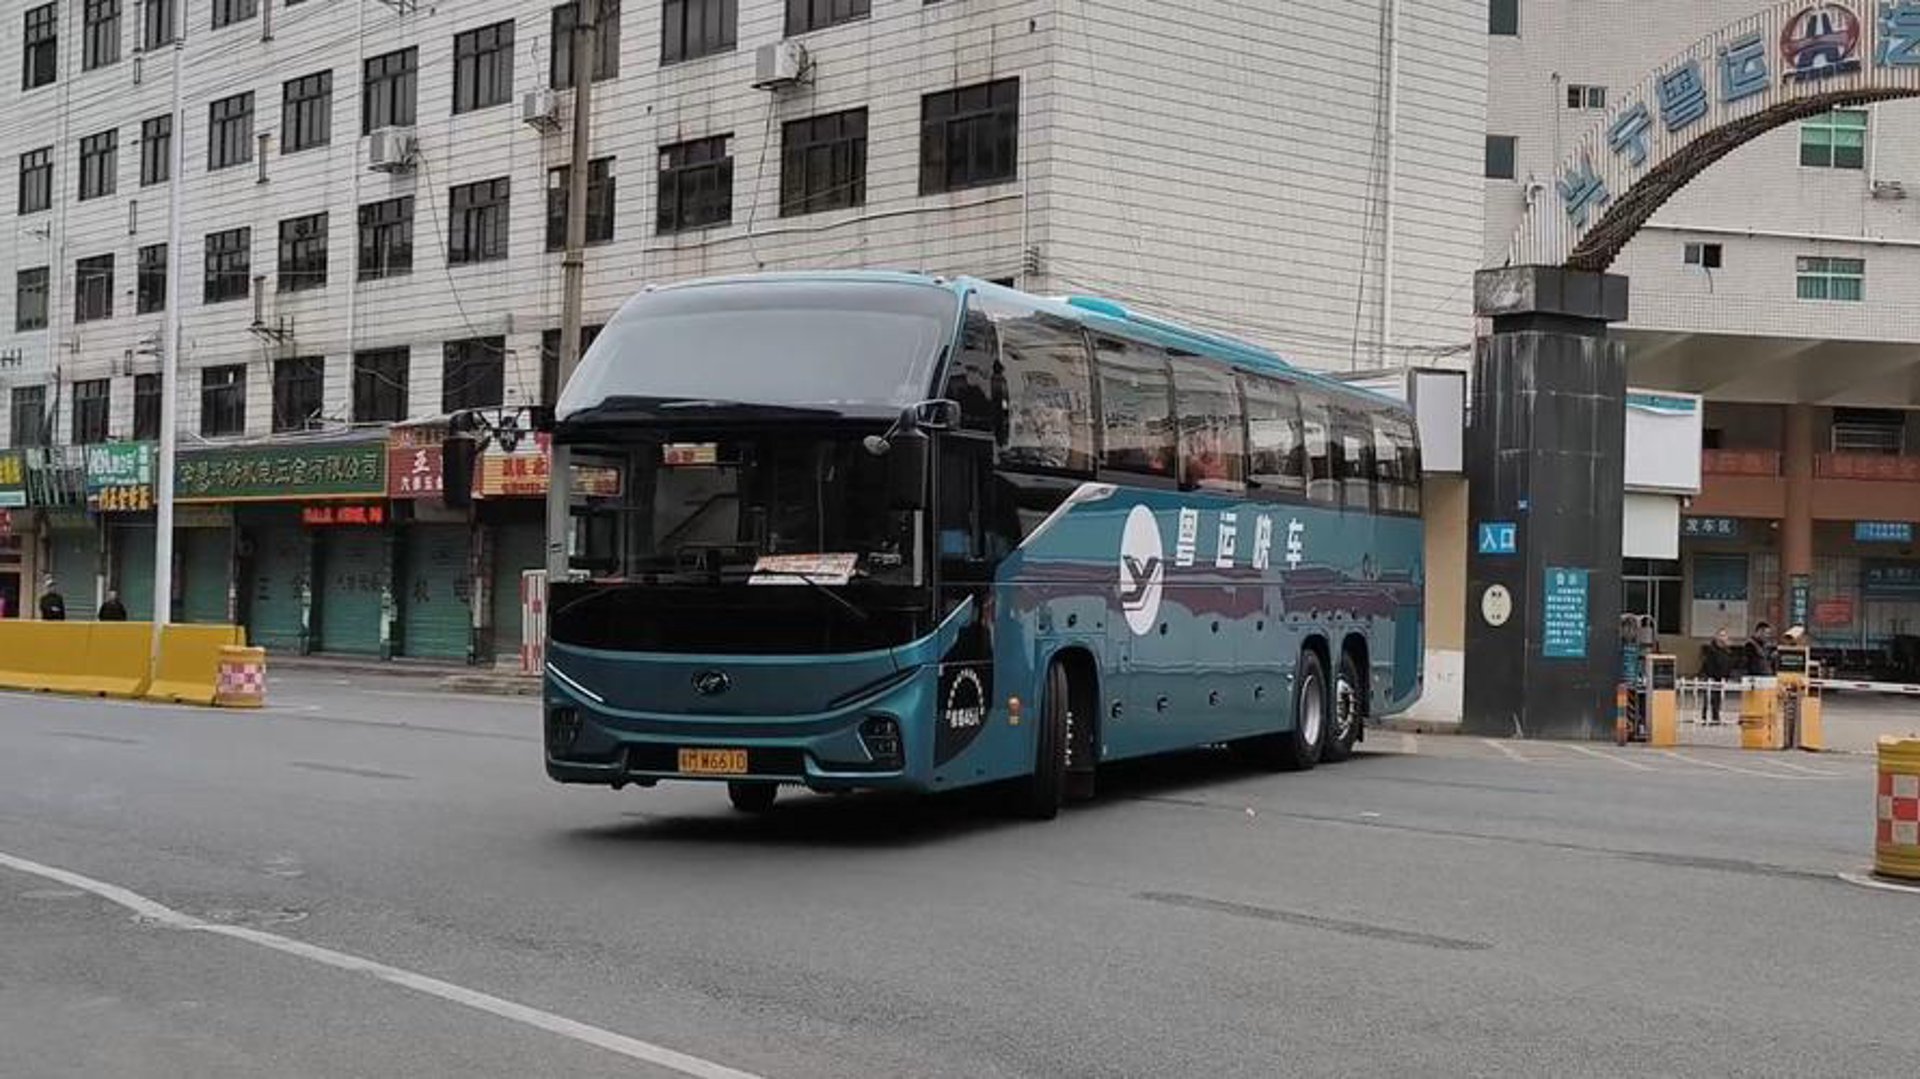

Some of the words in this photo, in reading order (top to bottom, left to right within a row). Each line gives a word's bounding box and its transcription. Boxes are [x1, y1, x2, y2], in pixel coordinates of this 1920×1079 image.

[1175, 506, 1304, 570] 粤运快车
[1482, 527, 1516, 549] 入口
